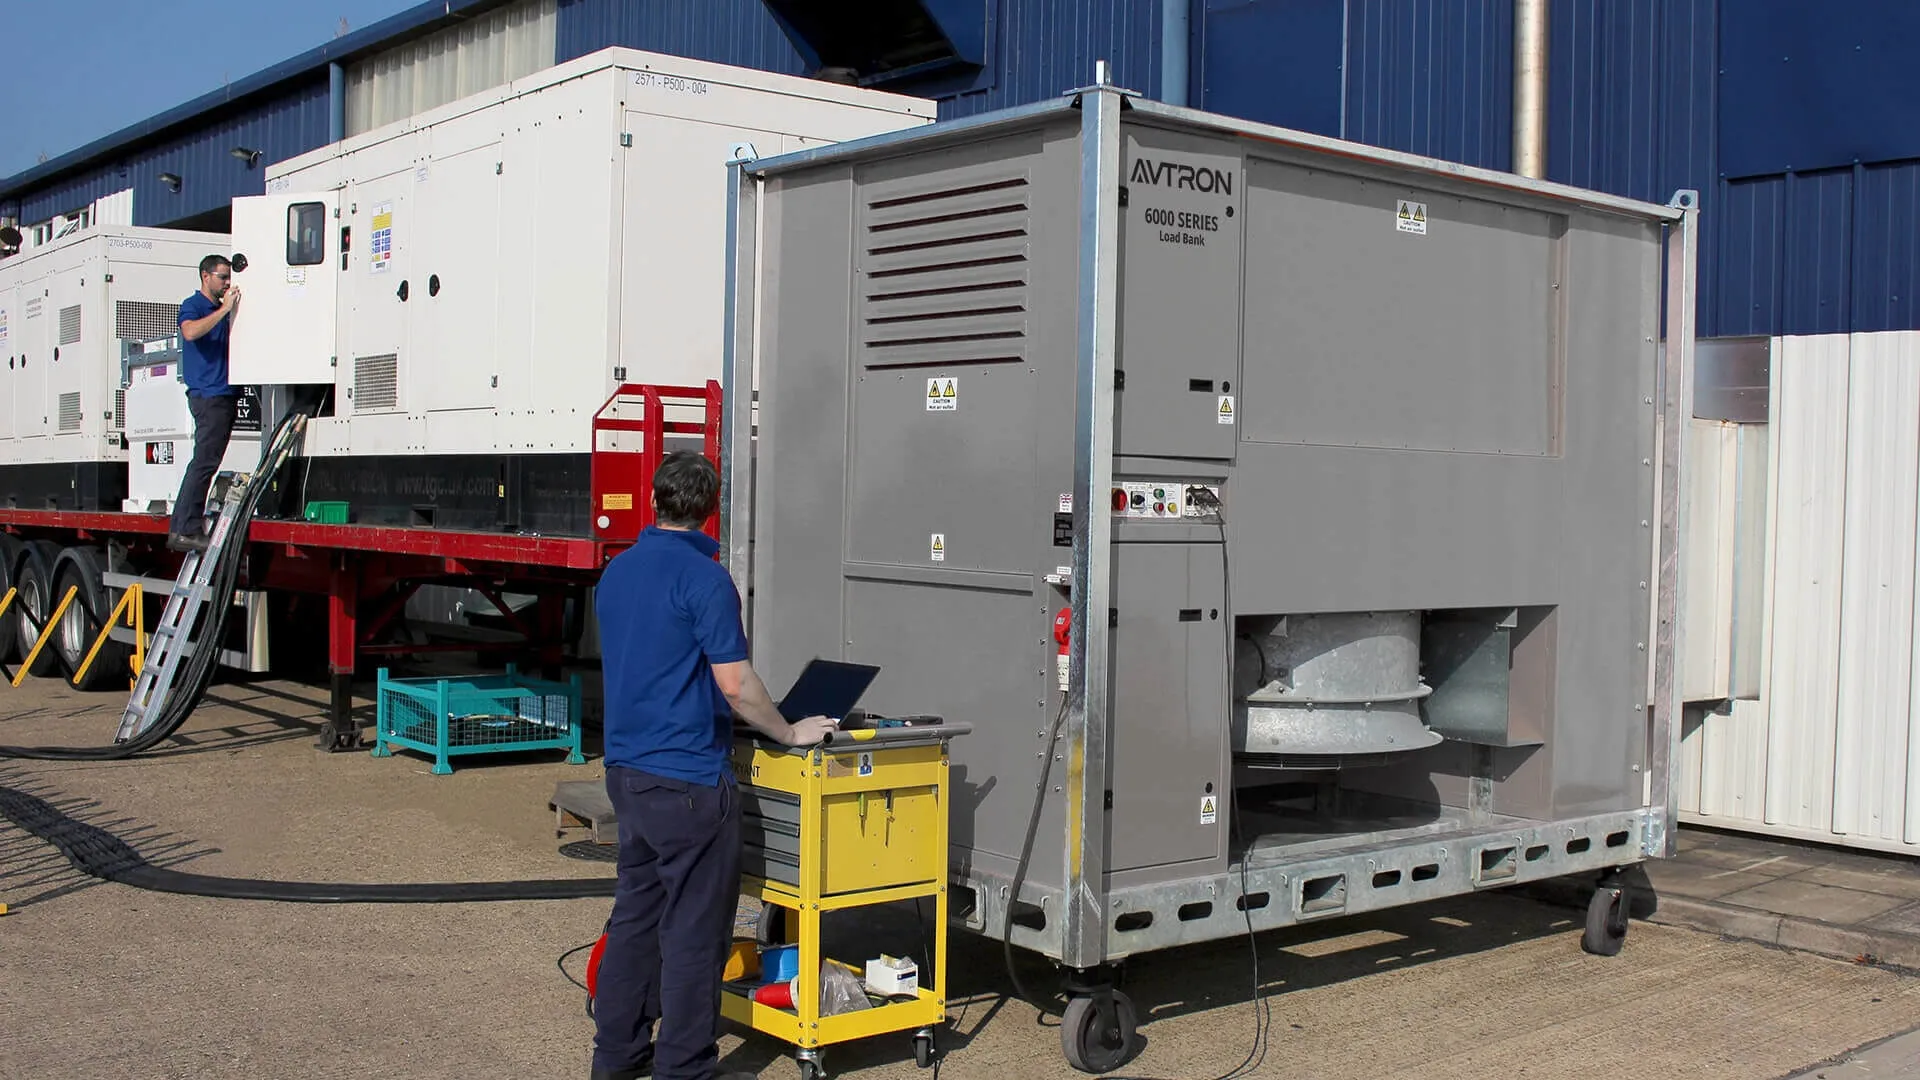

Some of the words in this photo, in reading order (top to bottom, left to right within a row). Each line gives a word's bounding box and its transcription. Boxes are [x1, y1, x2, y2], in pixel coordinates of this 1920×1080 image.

[635, 73, 655, 87] 2571
[663, 77, 685, 92] P500
[691, 82, 707, 95] 004
[1130, 158, 1232, 196] AVTRON
[1145, 208, 1175, 226] 6000
[1178, 212, 1218, 232] SERIES
[1160, 230, 1180, 244] Load
[1183, 233, 1205, 247] Bank
